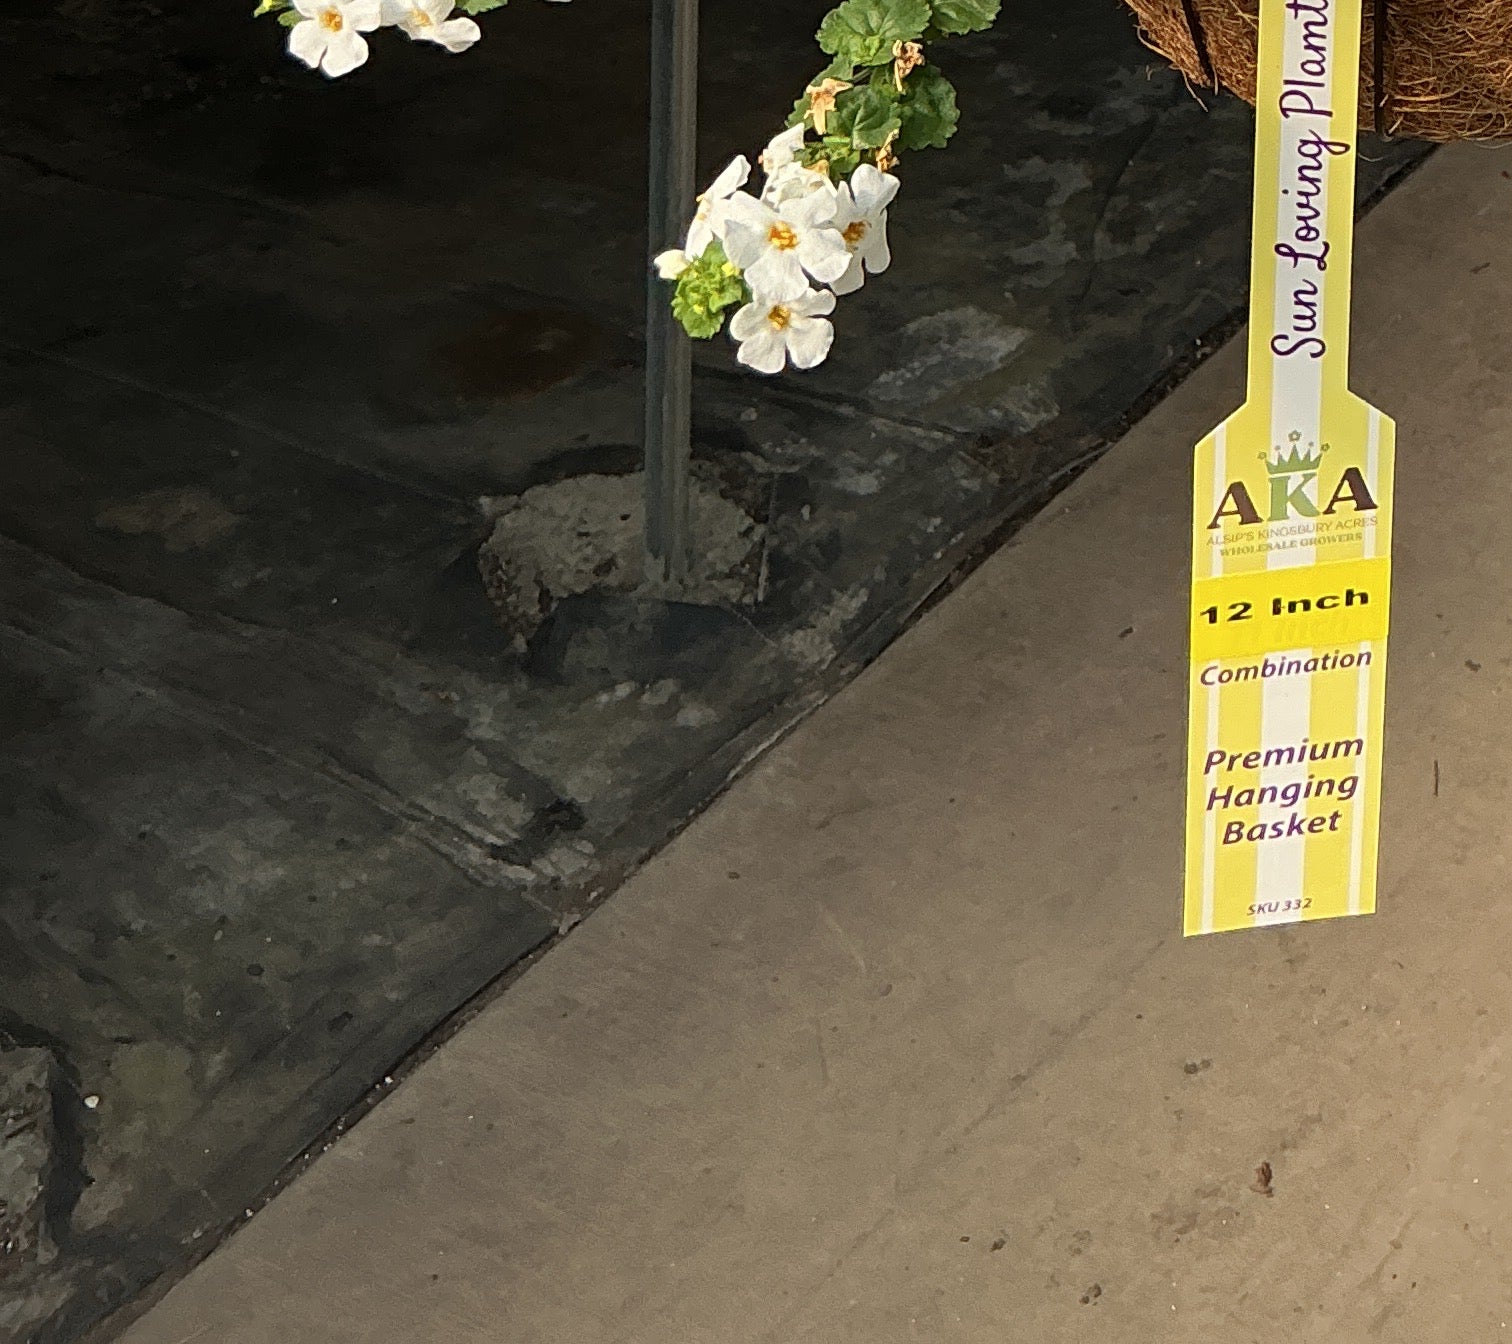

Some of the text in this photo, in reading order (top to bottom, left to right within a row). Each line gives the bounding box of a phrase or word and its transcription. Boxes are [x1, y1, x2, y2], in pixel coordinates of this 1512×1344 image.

[1274, 129, 1351, 272] Loving
[1271, 278, 1326, 359] Sun
[1207, 466, 1379, 530] AKA
[1336, 516, 1378, 529] ACRES
[1220, 532, 1363, 557] WHOLESALE GROWERS
[1200, 588, 1370, 624] 12 Inch
[1200, 649, 1372, 686] Combination
[1203, 737, 1364, 775] Premium
[1206, 774, 1359, 811] Hanging
[1222, 810, 1342, 845] Basket
[1246, 897, 1313, 916] SKU 332
